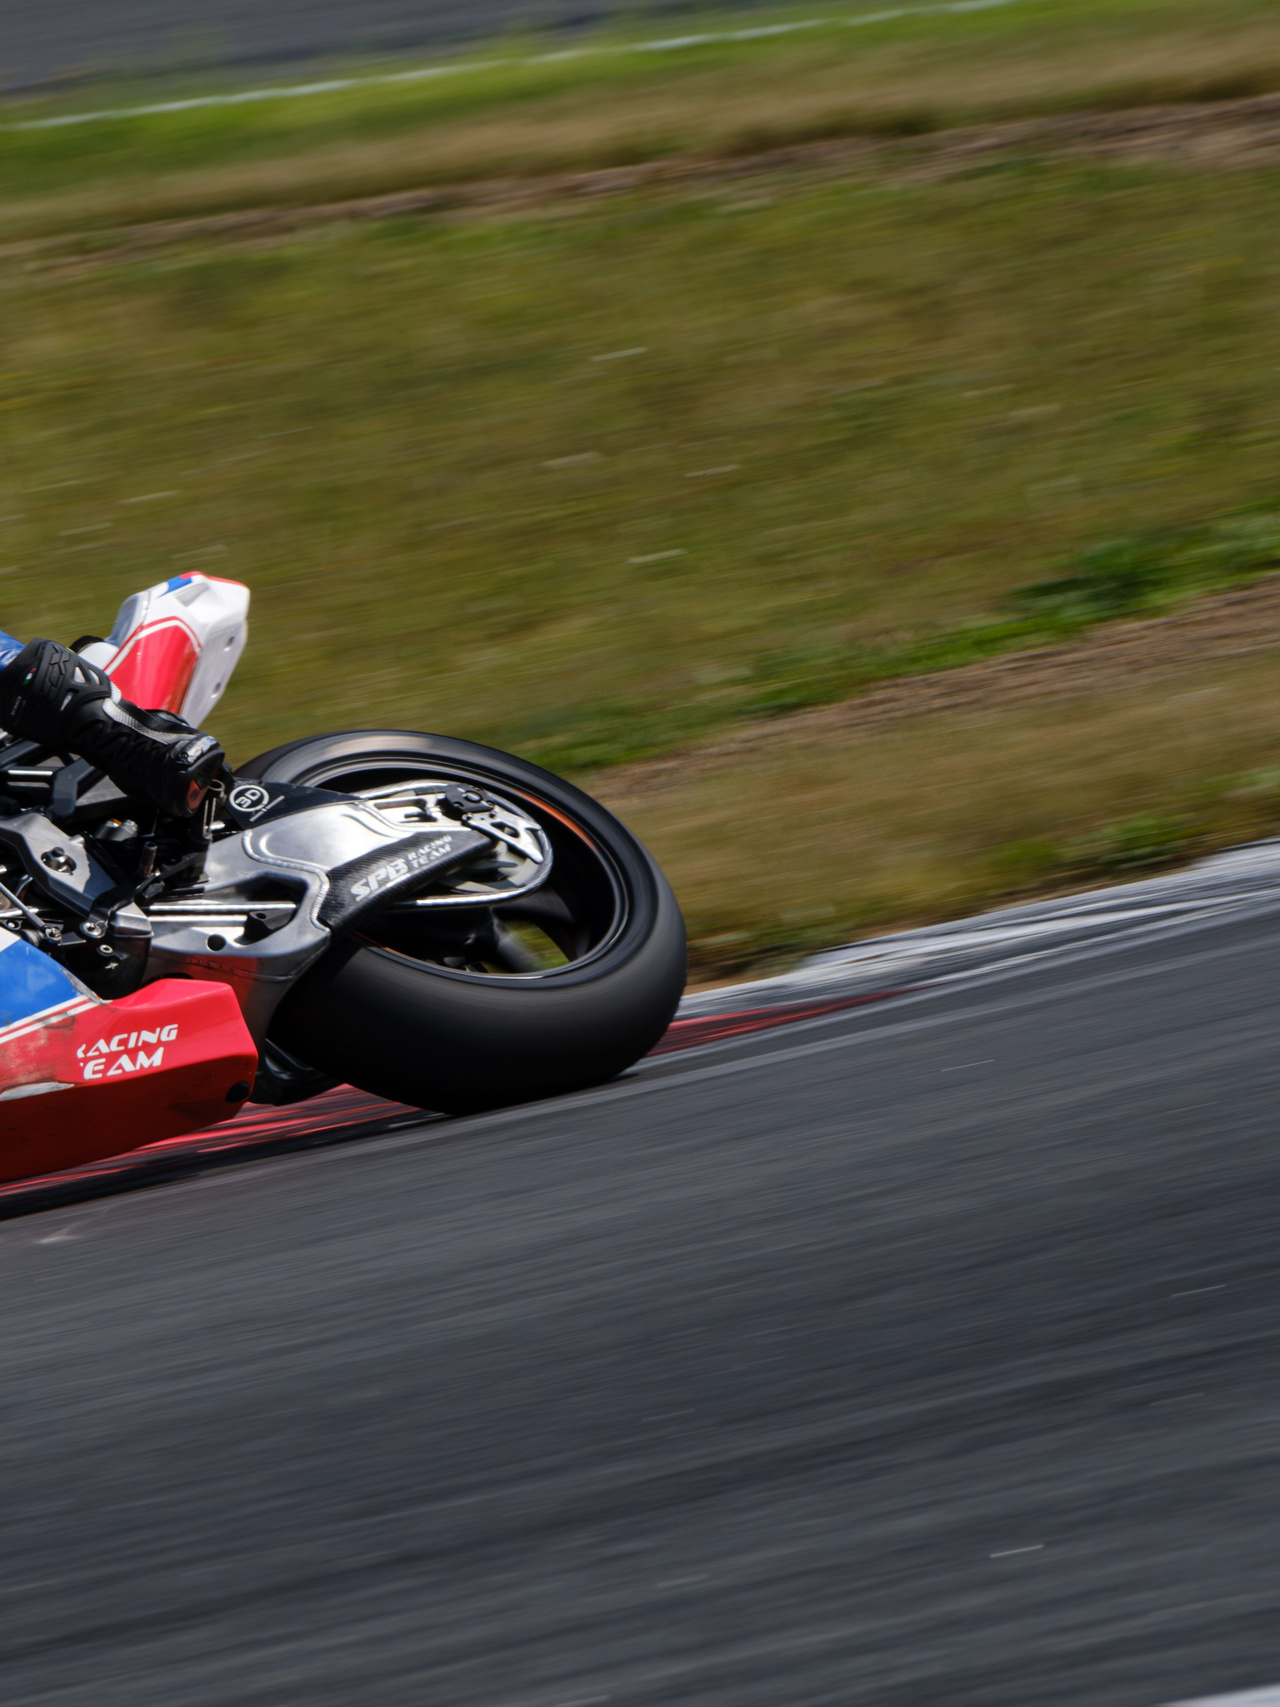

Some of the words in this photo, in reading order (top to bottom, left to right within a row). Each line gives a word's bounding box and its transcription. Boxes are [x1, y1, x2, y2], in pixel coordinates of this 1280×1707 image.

[235, 789, 262, 809] 3D
[407, 834, 453, 861] RACING
[411, 843, 452, 868] TEAM
[350, 858, 409, 902] SPB
